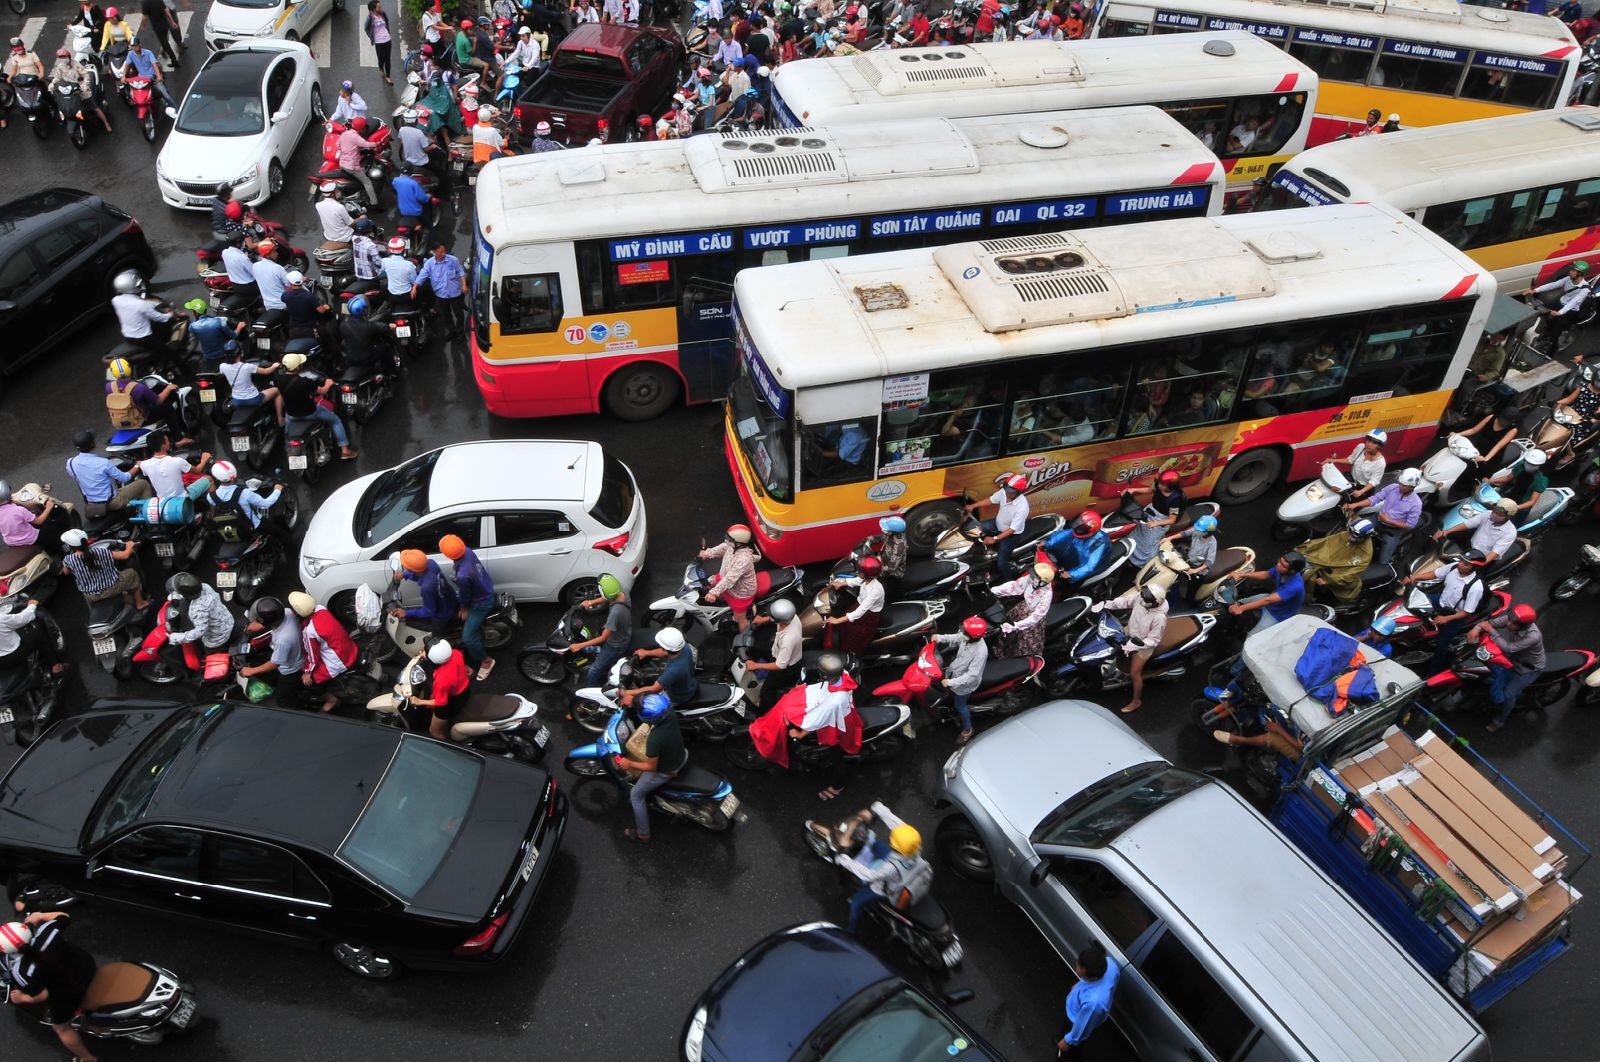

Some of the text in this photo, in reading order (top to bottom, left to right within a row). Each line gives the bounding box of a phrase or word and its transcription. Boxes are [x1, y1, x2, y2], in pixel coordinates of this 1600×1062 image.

[1158, 13, 1168, 22] BX
[1485, 56, 1497, 65] BX
[1119, 190, 1195, 212] TRUNG HÀ
[872, 210, 981, 236] SƠN TÂY QUẢNG
[995, 203, 1086, 224] OAI QL 32
[615, 232, 732, 258] MỸ ĐÌNH CẦU
[750, 223, 857, 247] VƯỢT PHÙNG
[567, 328, 585, 342] 70
